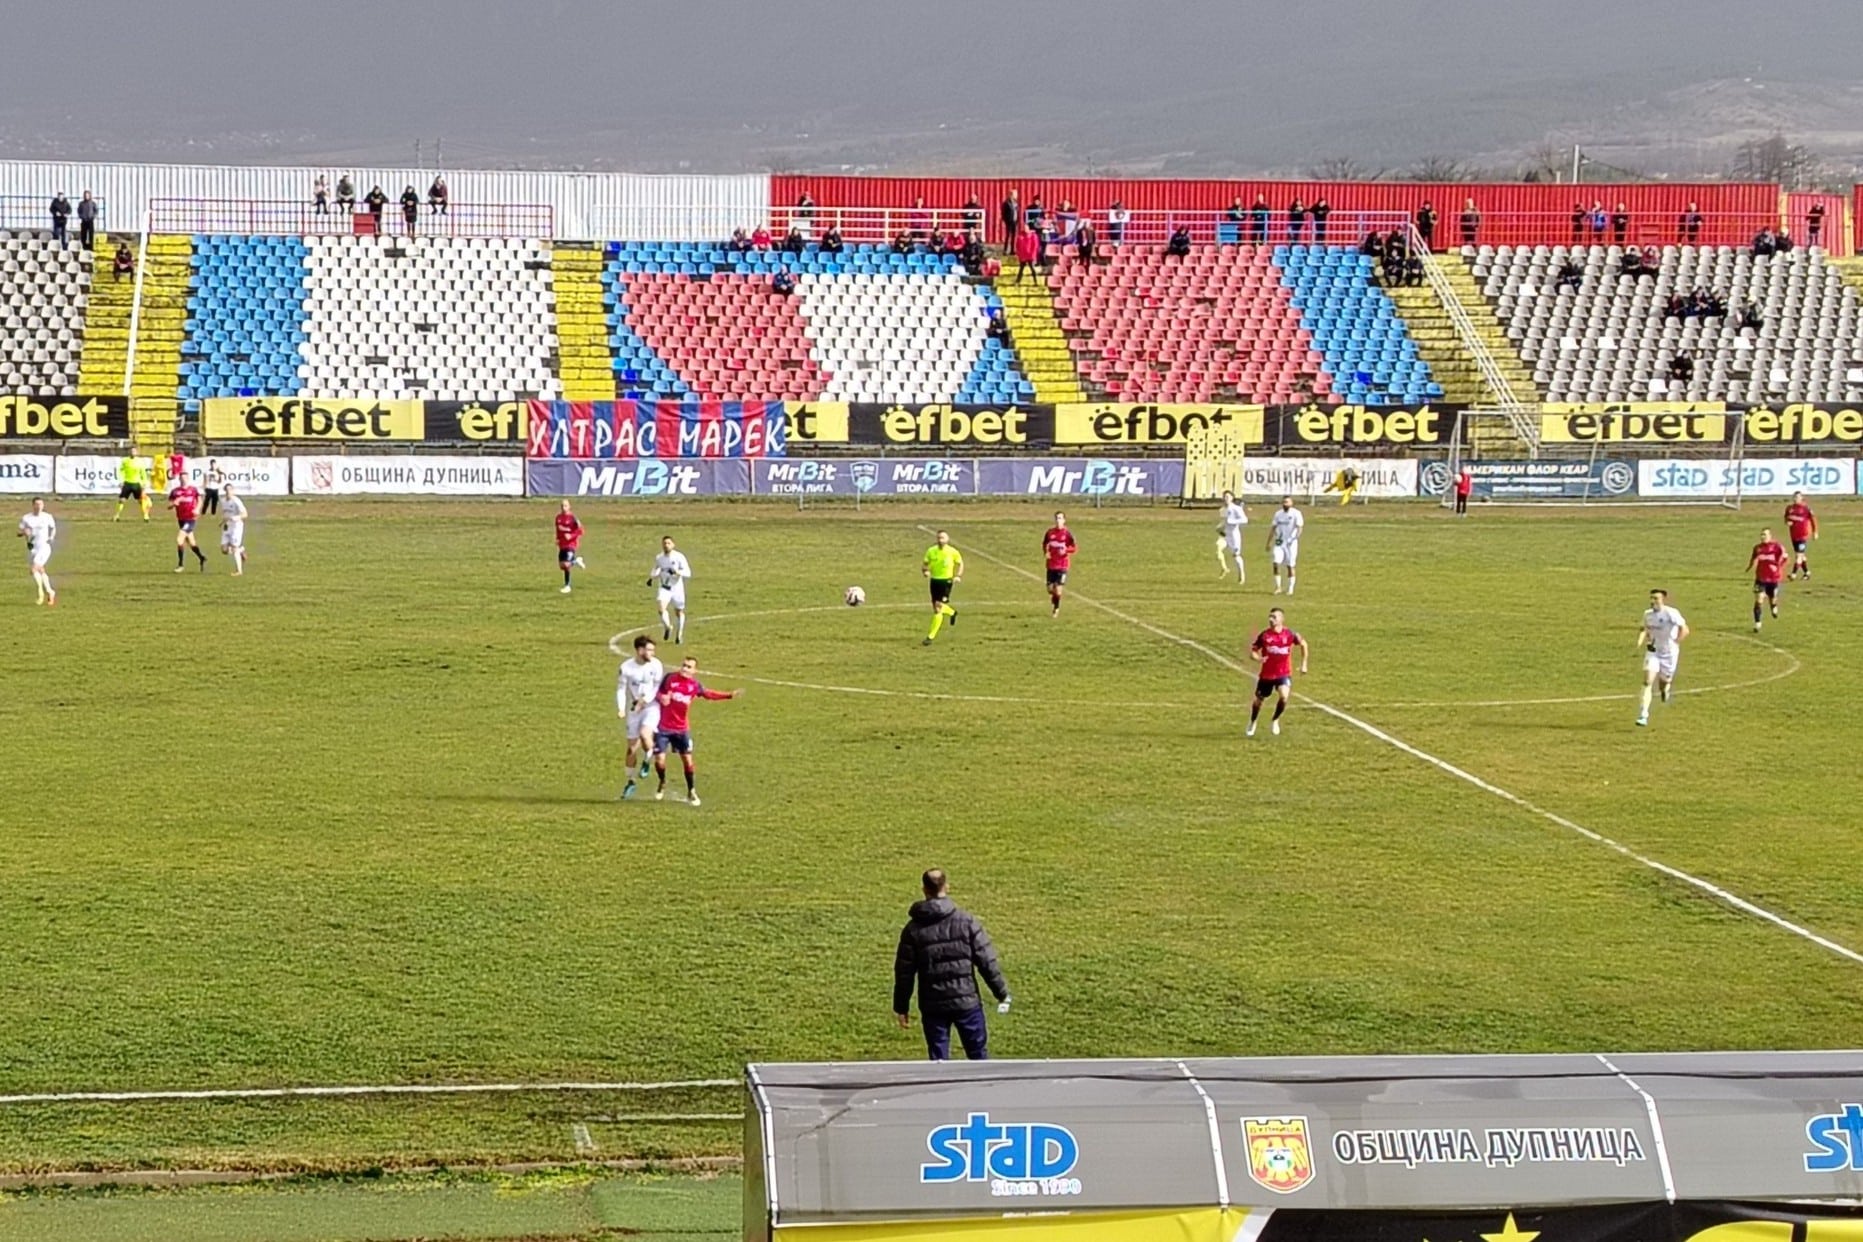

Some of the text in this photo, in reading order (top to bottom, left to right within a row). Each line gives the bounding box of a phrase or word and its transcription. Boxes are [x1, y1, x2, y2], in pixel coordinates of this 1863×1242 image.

[529, 418, 657, 457] УЛТРАС
[677, 416, 787, 457] МАРЕК
[341, 467, 504, 486] ОБЩИНА ДУПНИЦА
[577, 459, 701, 496] MrBit
[767, 461, 837, 481] MrBit
[892, 461, 962, 481] MrBit
[1027, 459, 1148, 495] MrBit
[1333, 1128, 1647, 1169] ОБЩИНА ДУПНИЦА
